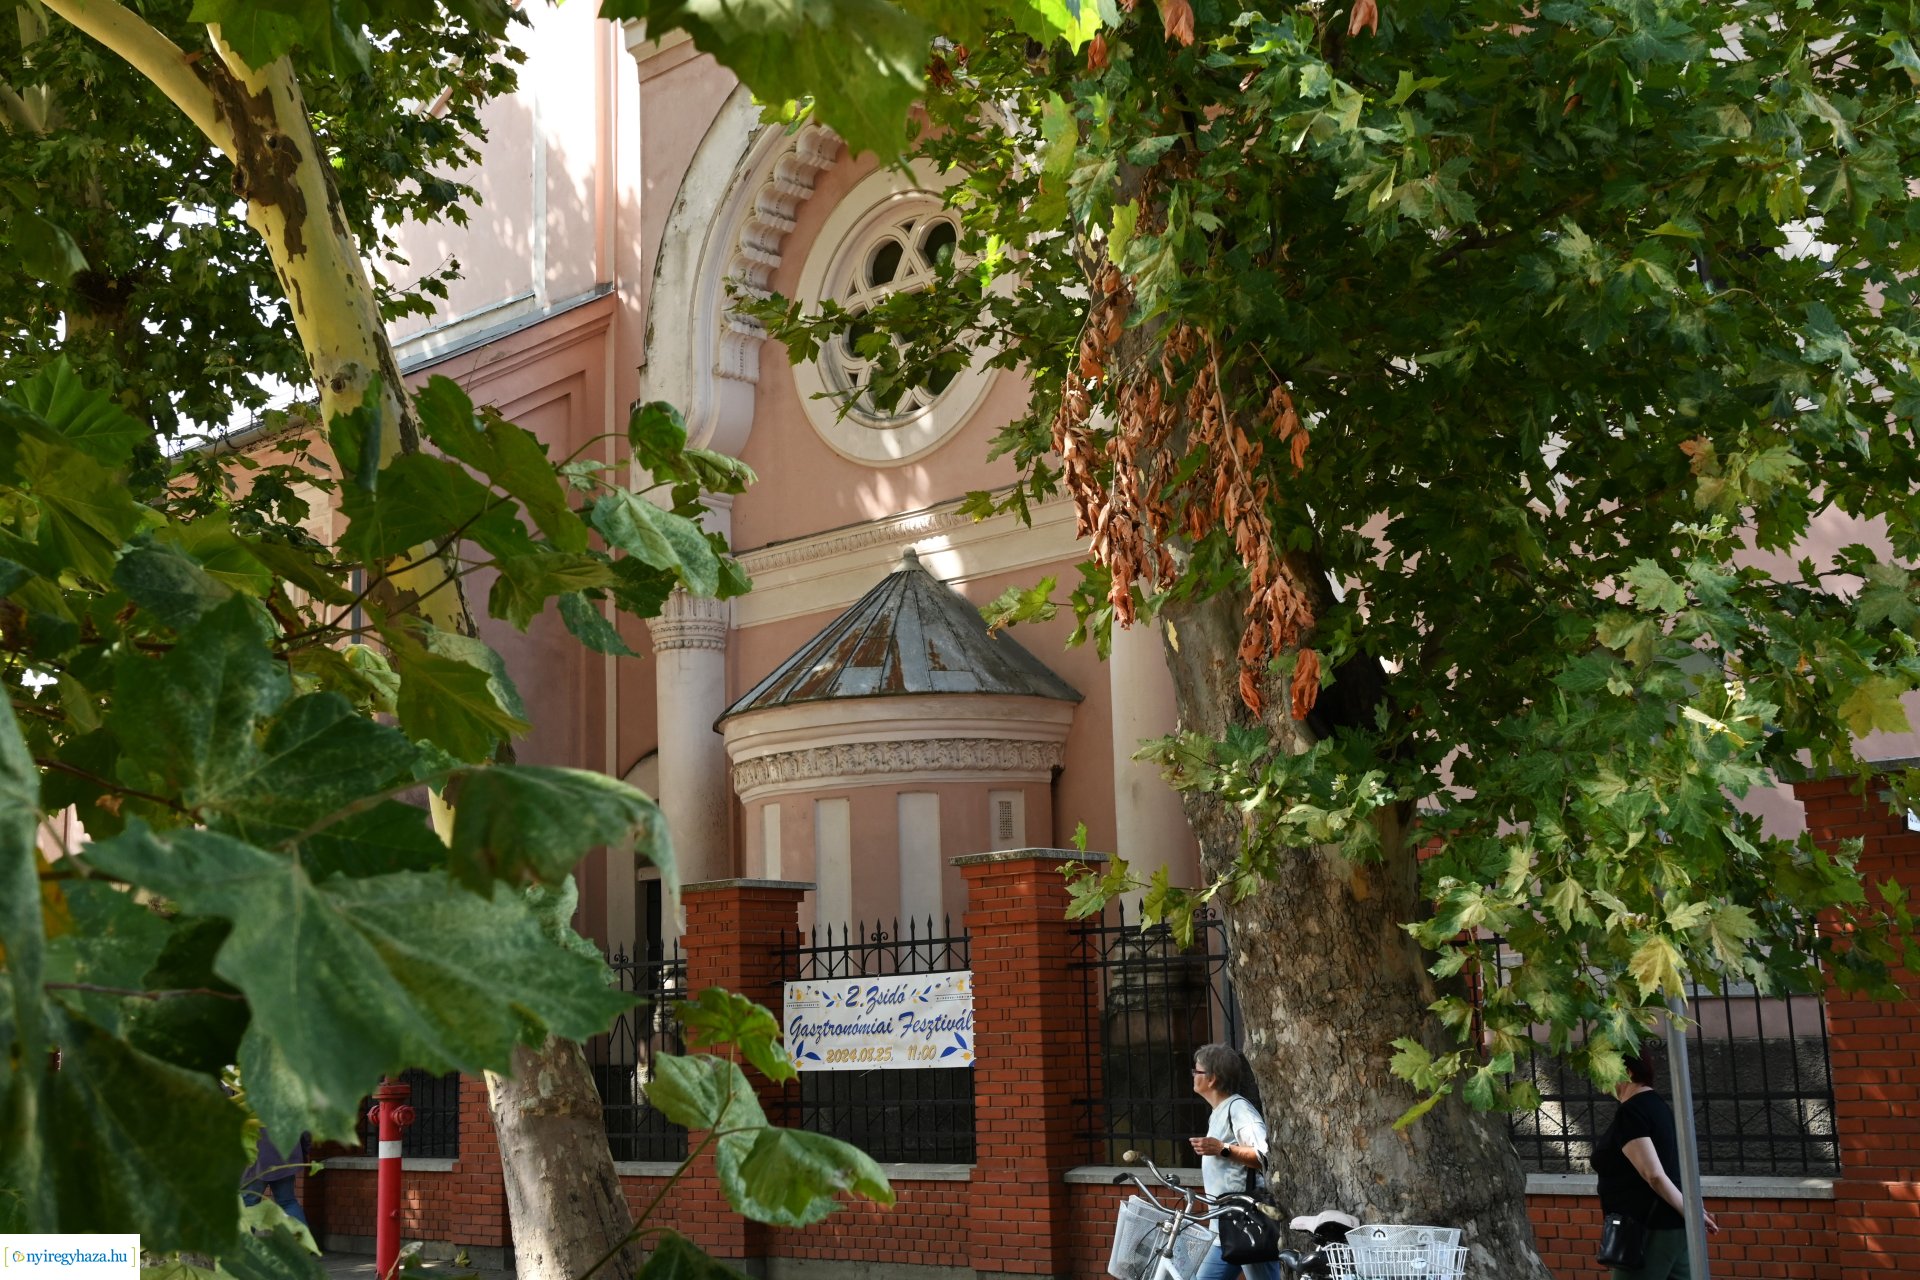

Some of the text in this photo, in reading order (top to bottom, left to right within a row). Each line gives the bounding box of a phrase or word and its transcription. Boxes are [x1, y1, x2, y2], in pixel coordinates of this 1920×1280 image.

[866, 983, 909, 1015] Zsidó
[789, 1009, 974, 1045] Gasztronómiai Fesztivál
[825, 1044, 938, 1064] 2024.08.25. 11:00
